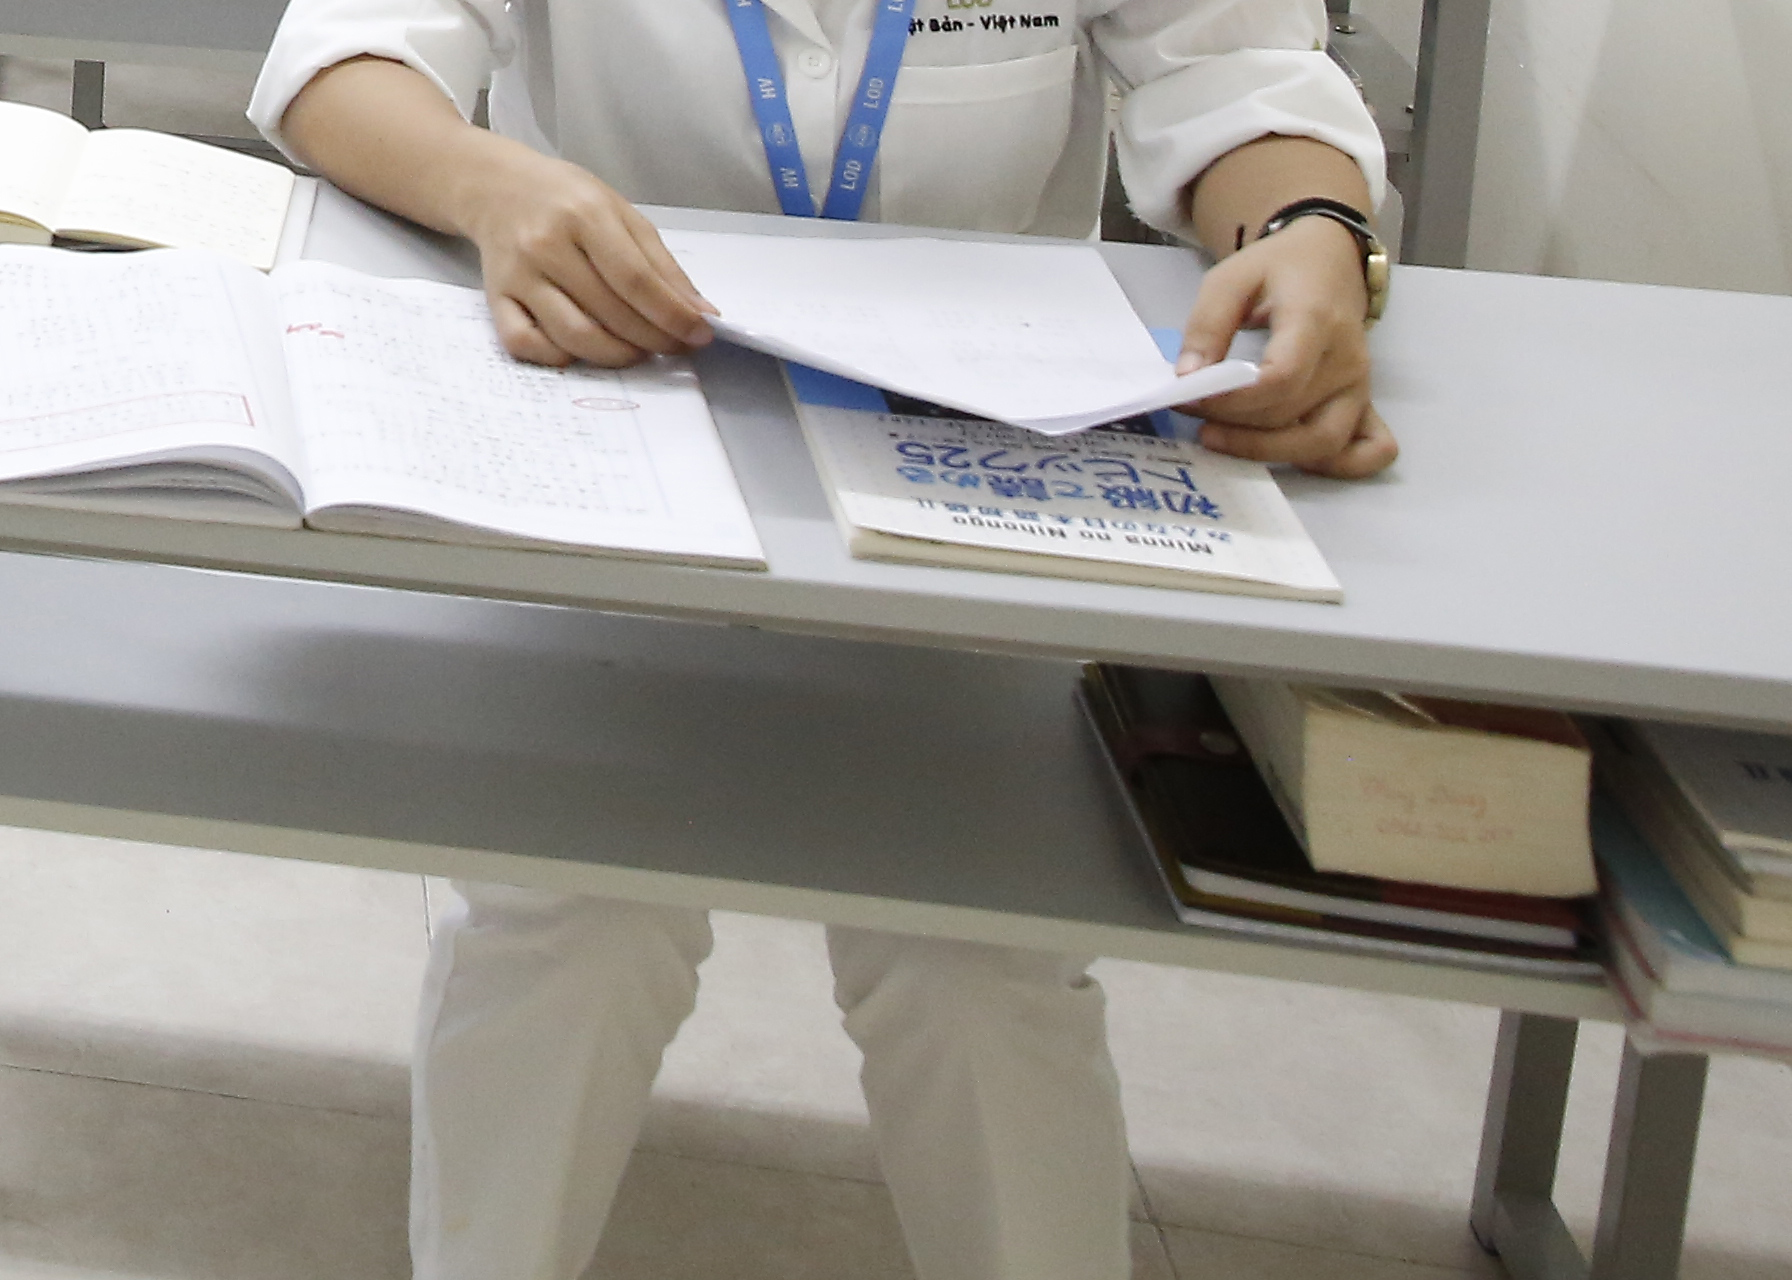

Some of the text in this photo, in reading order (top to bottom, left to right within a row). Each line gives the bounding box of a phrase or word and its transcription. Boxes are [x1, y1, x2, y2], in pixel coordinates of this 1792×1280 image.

[928, 13, 1060, 34] Bản Việt Nam
[758, 76, 777, 101] HV
[863, 76, 884, 110] LOD
[782, 165, 799, 190] HV
[842, 159, 862, 194] LOD
[952, 514, 1067, 541] Nihongo
